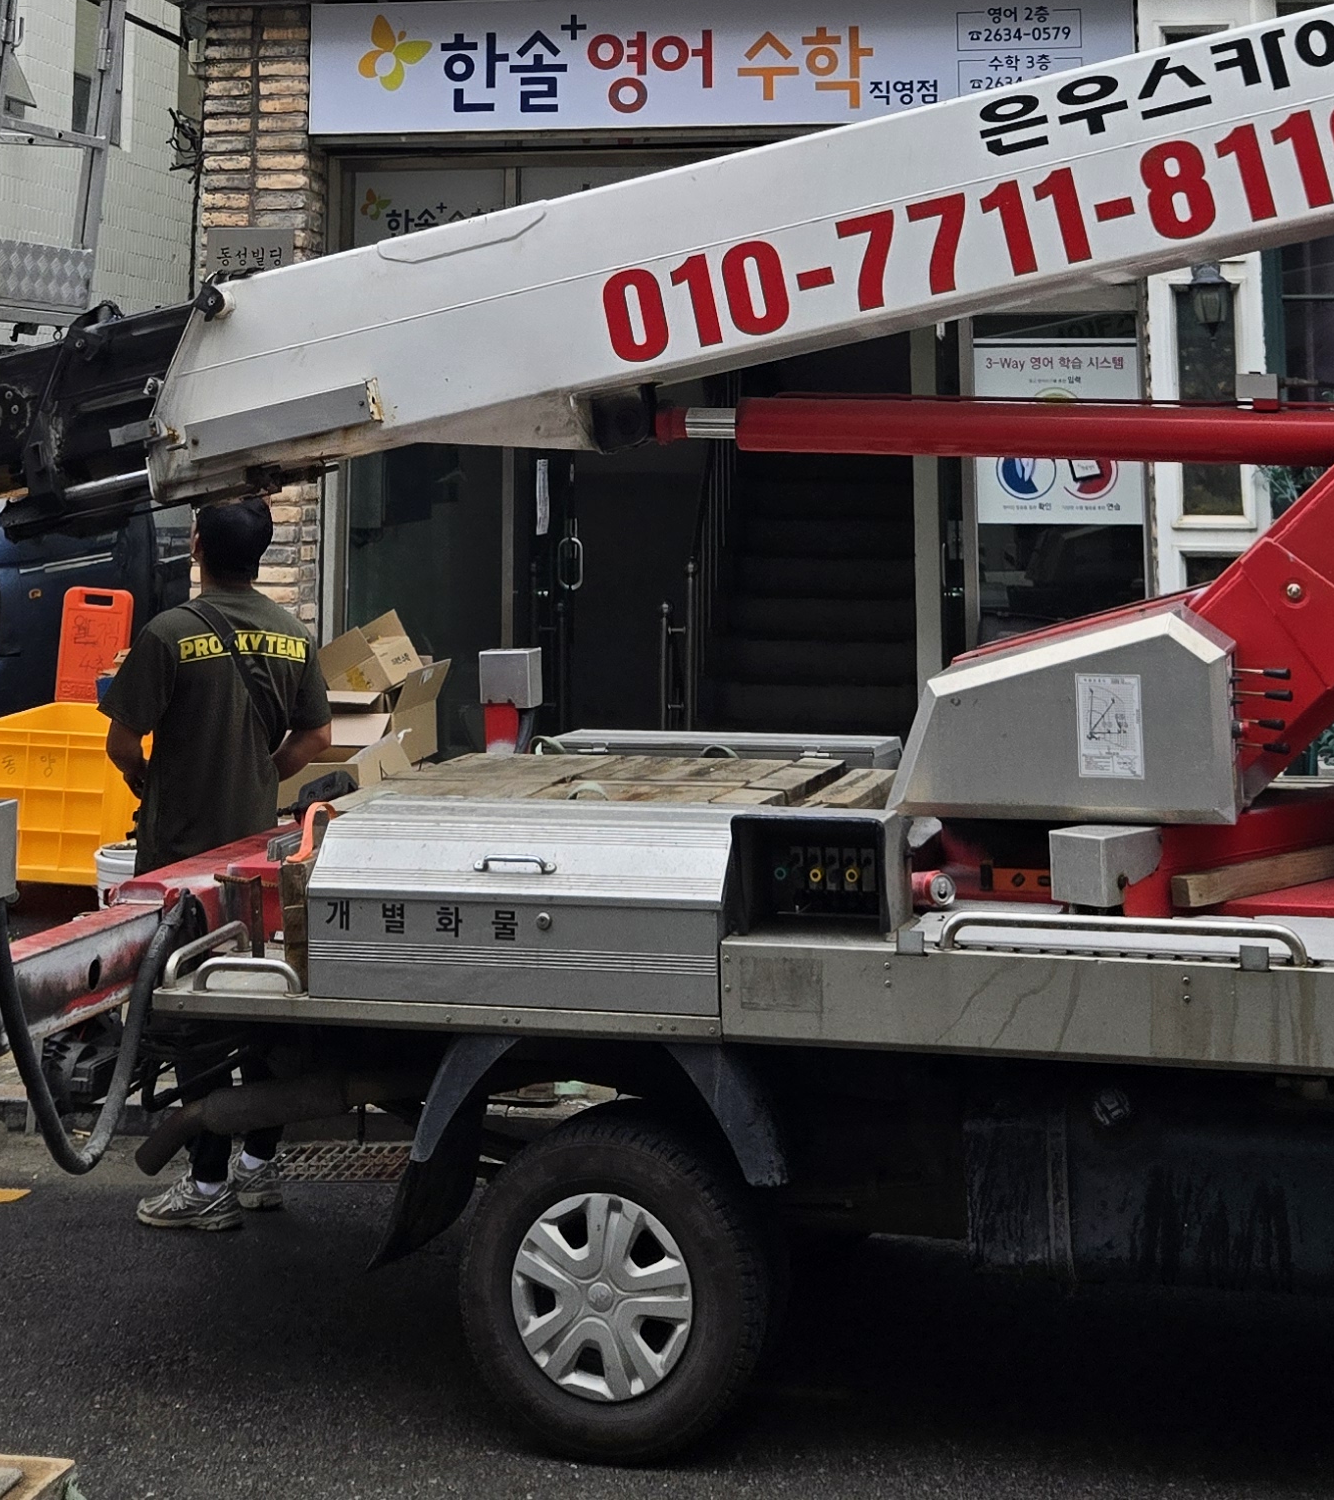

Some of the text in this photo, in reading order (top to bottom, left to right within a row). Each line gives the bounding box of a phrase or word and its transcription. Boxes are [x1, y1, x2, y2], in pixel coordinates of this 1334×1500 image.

[987, 6, 1050, 24] 영어 2층
[984, 26, 1071, 42] 2634-0579
[737, 26, 873, 110] 수학
[869, 79, 938, 105] 직영점
[988, 54, 1051, 71] 수학 3층
[217, 248, 283, 267] 동성빌딩
[986, 357, 1124, 372] 3-Way 영어 학습 시스템
